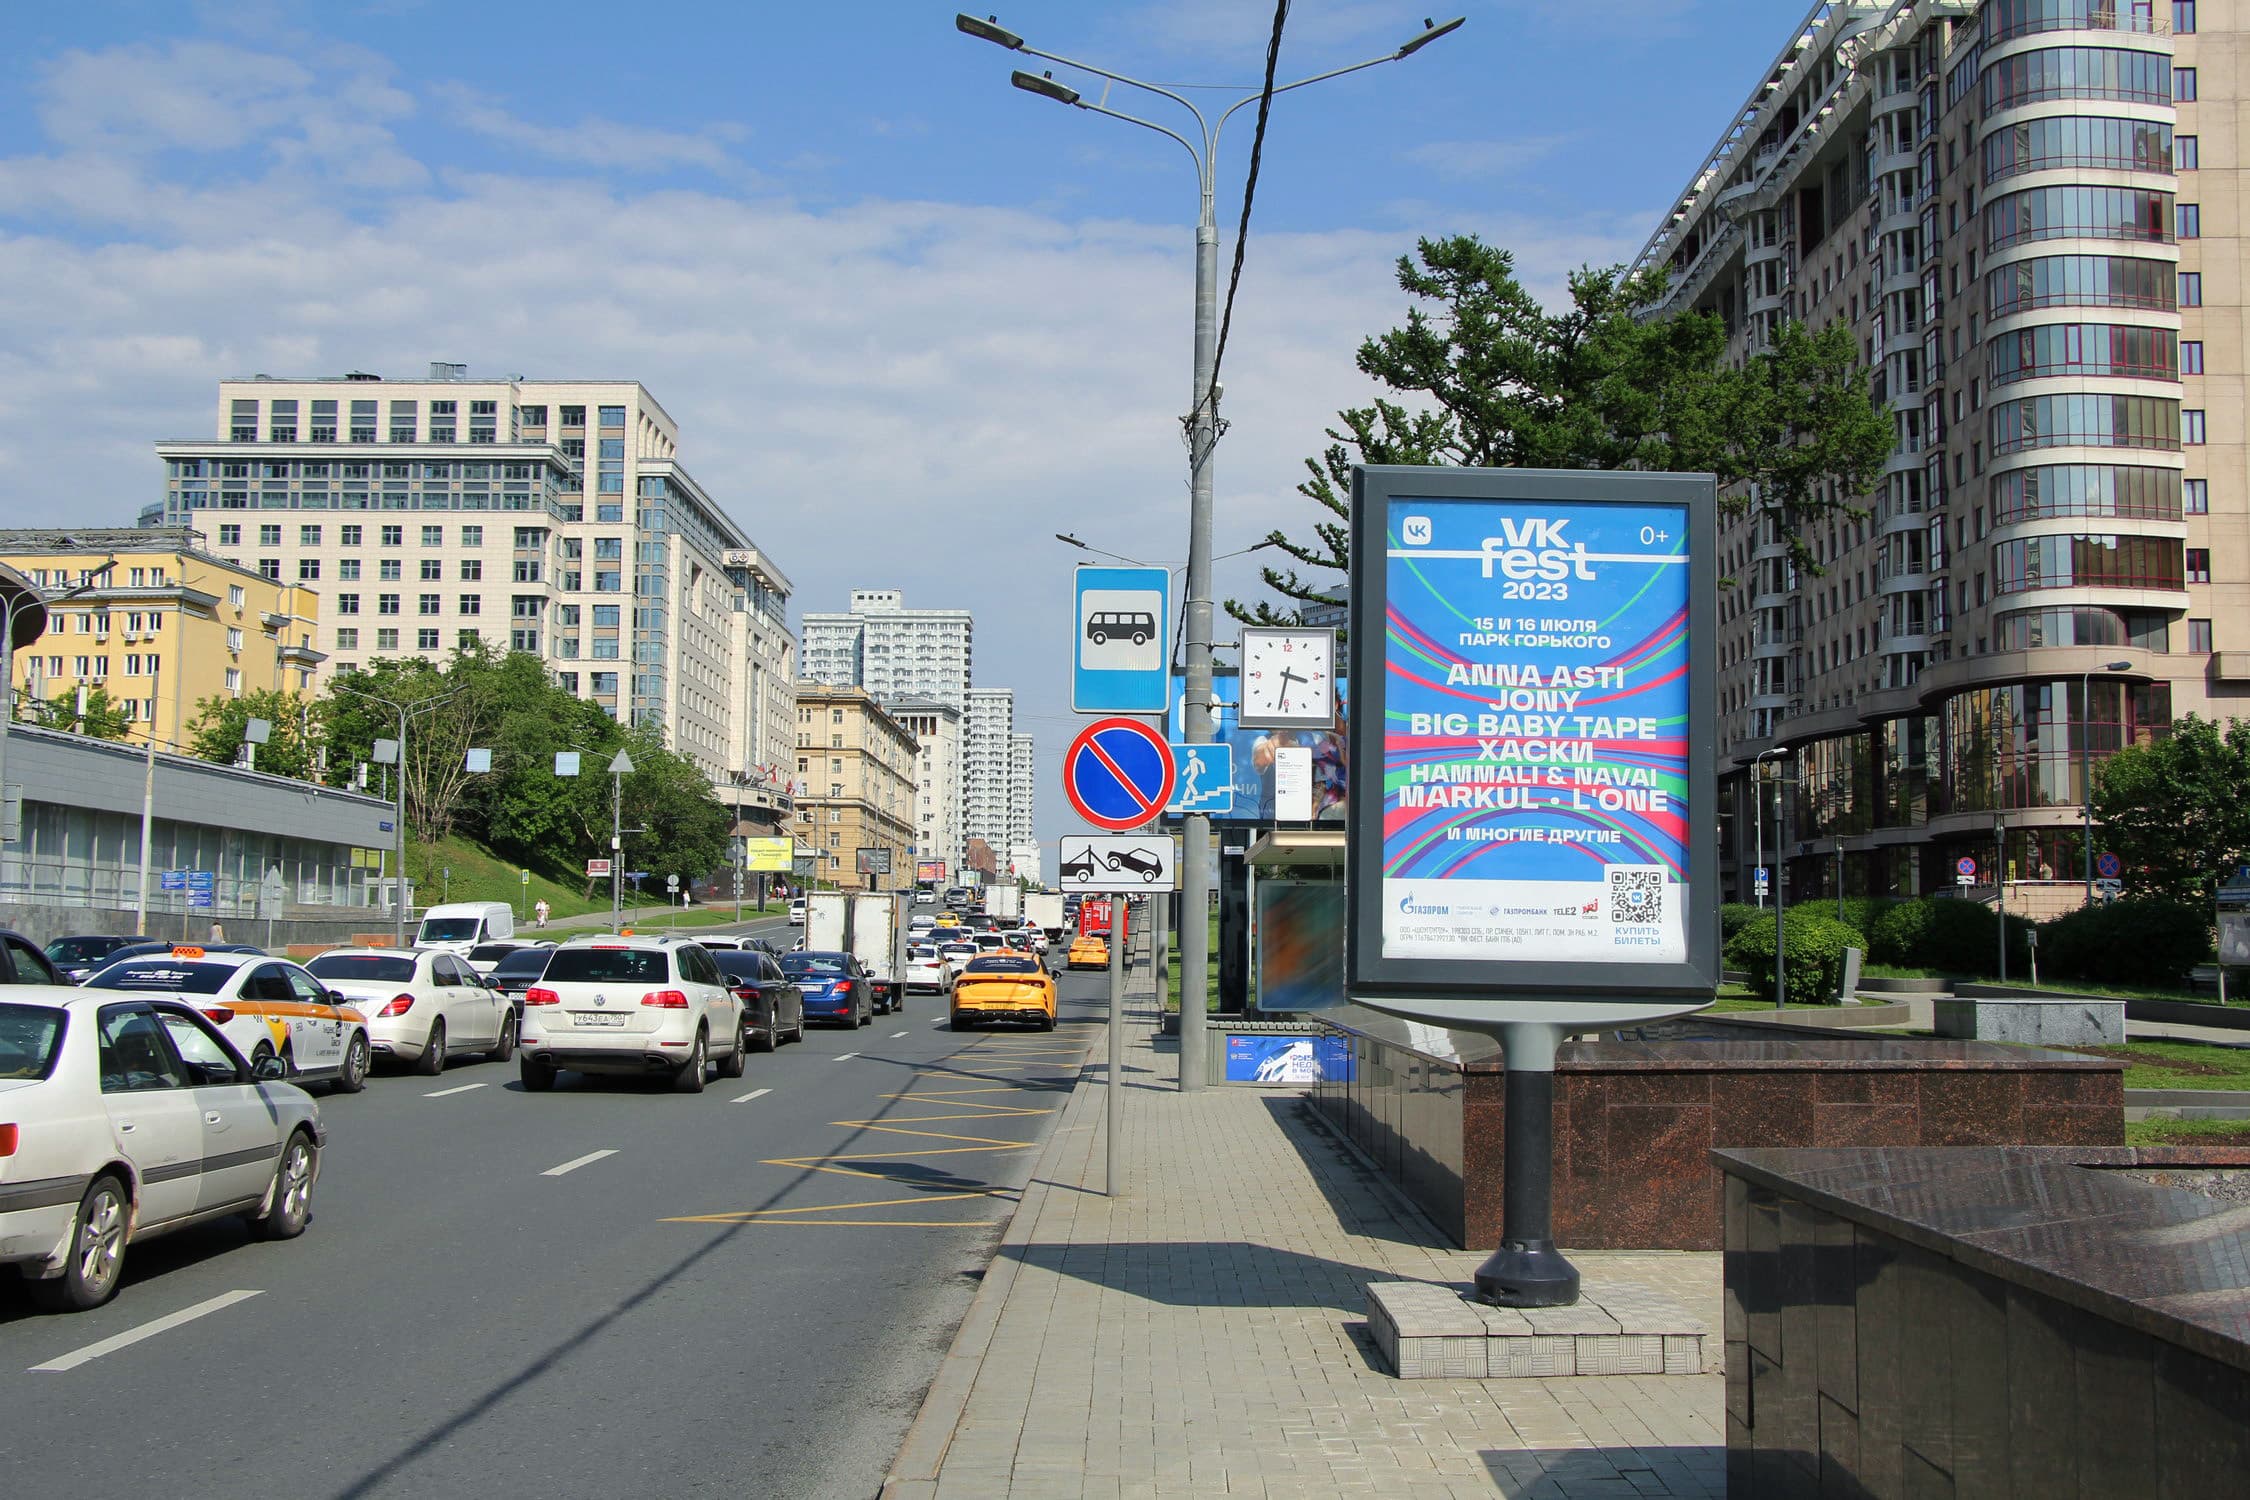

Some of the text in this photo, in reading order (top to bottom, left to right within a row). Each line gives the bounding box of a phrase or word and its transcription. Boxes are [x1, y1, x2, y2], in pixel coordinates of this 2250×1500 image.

[1500, 518, 1570, 548] VK
[1640, 525, 1669, 545] 0+
[1482, 538, 1596, 581] fest
[1503, 582, 1568, 600] 2023
[1473, 618, 1597, 633] 15 И 16 ИЮЛЯ
[1283, 644, 1293, 652] 12
[1459, 633, 1611, 649] ПАРК ГОРЬКОГО
[1255, 671, 1262, 679] 9
[1313, 672, 1319, 680] 3
[1446, 663, 1624, 689] ANNA ASTI
[1283, 699, 1290, 707] 6
[1488, 689, 1581, 712] JONY
[1411, 713, 1656, 740] BIG BABY TAPE
[1477, 739, 1594, 763] ХАСКИ
[1410, 764, 1657, 787] HAMMALI & NAVAI
[1399, 786, 1539, 809] MARKUL
[1573, 788, 1668, 812] L'ONE
[1448, 828, 1621, 844] И МНОГИЕ ДРУГИЕ
[1414, 905, 1449, 915] ГАЗПРОМ
[1503, 908, 1548, 916] ГАЗПРОМБАНК
[1554, 907, 1577, 916] TELE2
[1615, 927, 1660, 935] КУПИТЬ
[1614, 936, 1661, 945] БИЛЕТЫ
